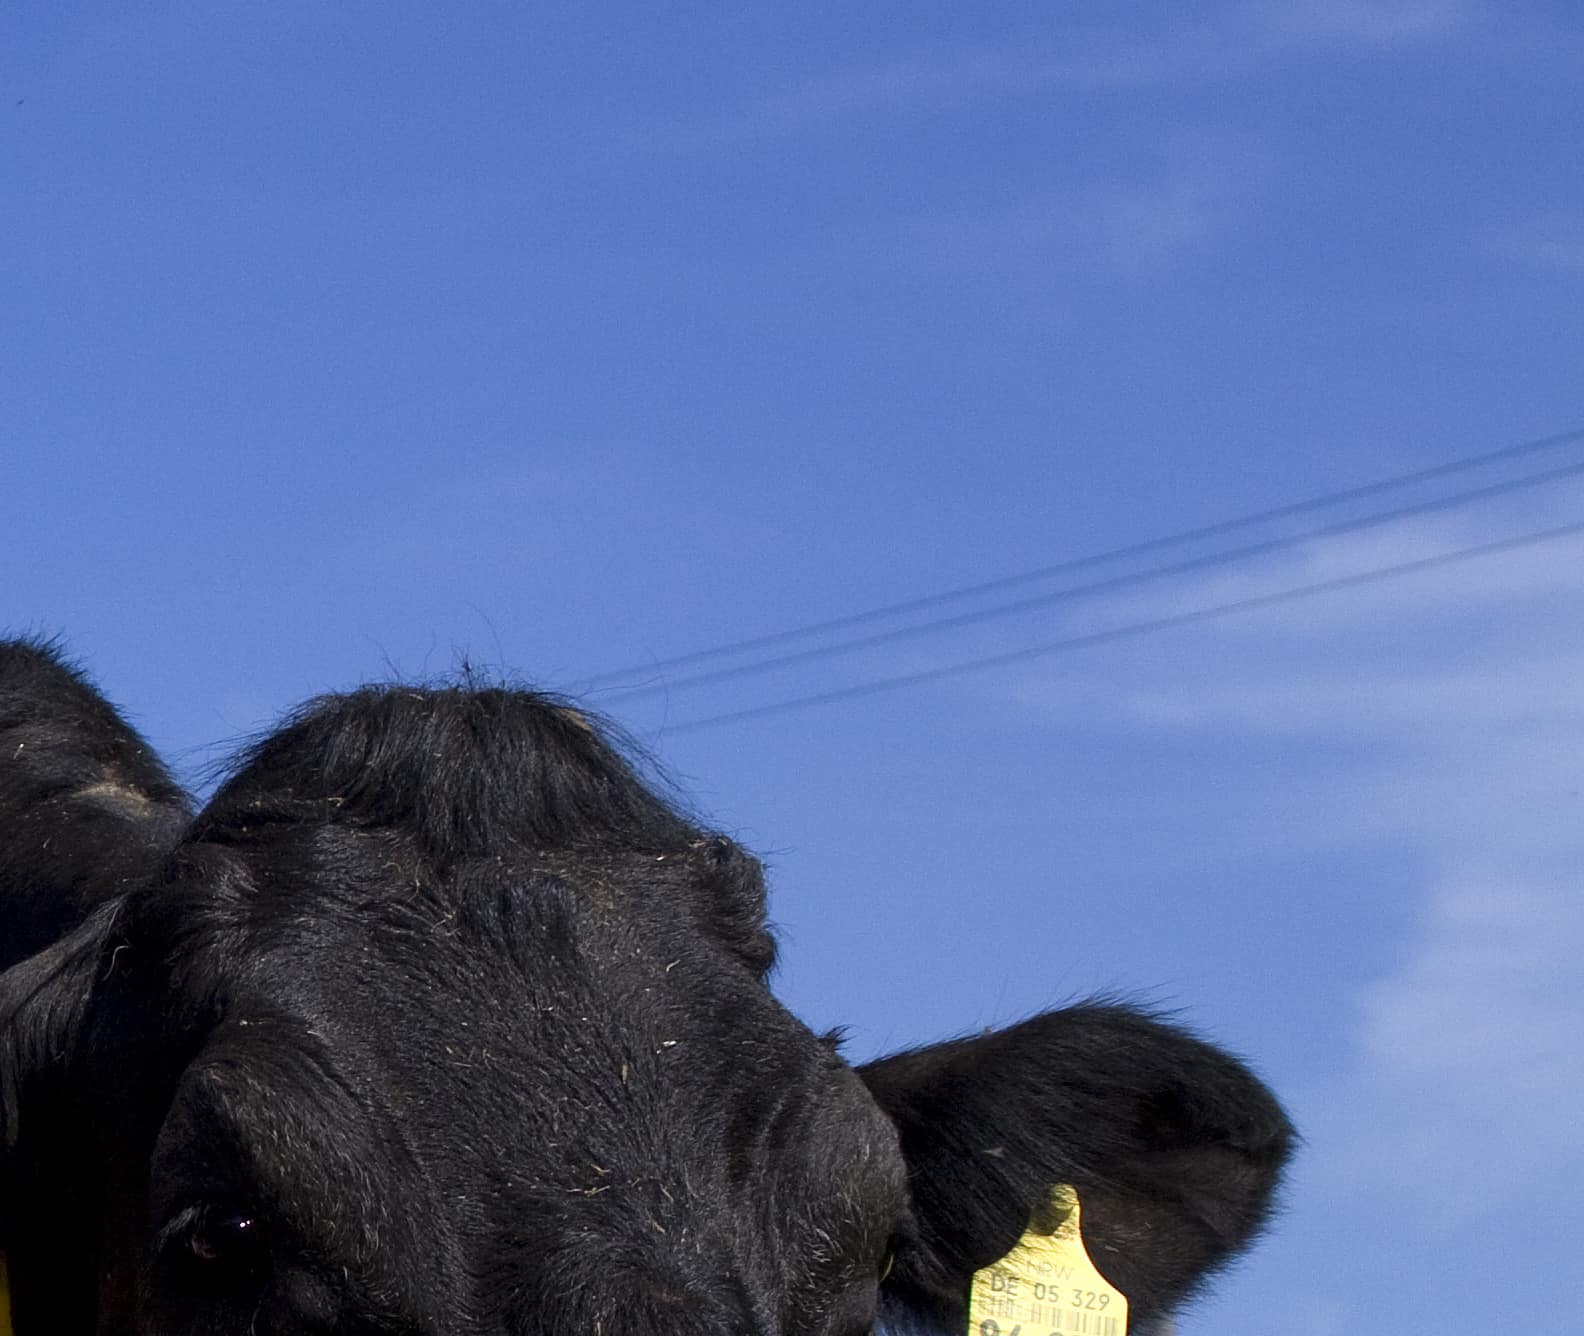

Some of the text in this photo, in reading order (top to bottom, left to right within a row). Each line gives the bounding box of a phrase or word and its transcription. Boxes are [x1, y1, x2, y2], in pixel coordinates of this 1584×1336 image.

[991, 1273, 1110, 1312] DE 05 329
